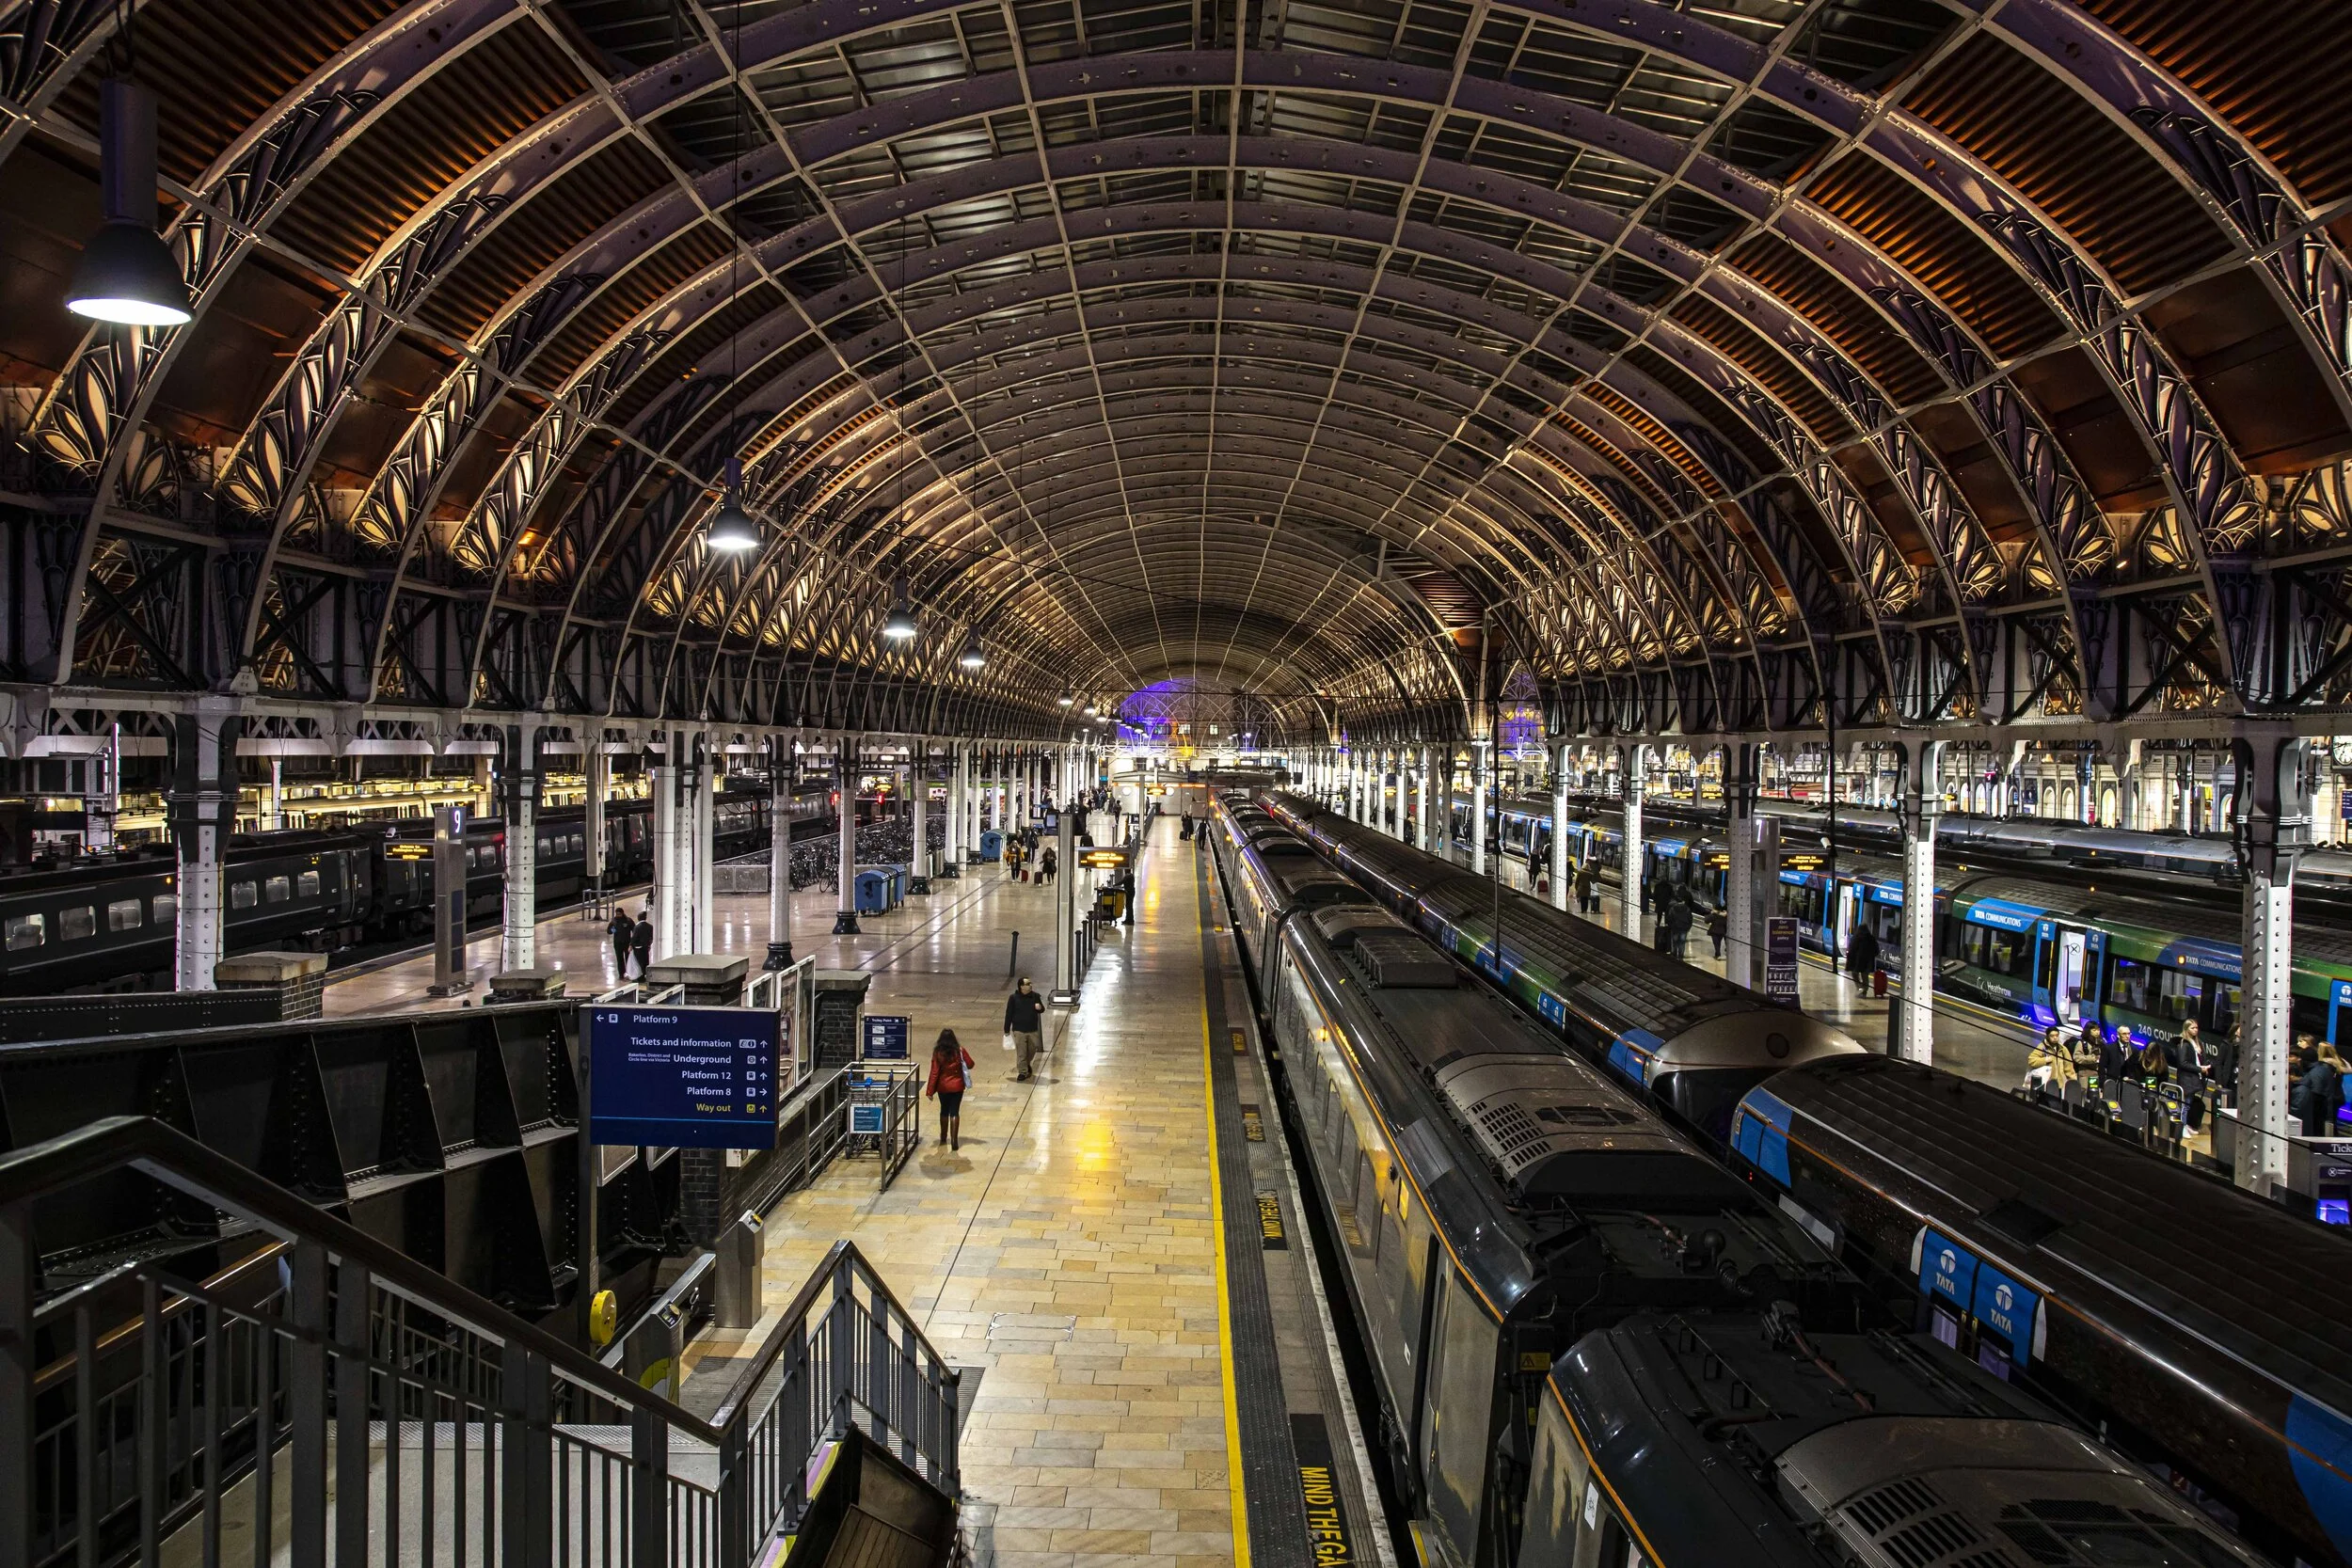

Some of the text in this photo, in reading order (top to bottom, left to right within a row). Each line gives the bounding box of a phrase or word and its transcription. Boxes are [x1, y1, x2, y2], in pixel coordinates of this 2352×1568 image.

[453, 810, 461, 833] 9
[1975, 910, 2022, 927] TATA COMMUNICATIONS
[2185, 956, 2200, 965] TATA
[1987, 981, 2011, 998] Heathrow
[633, 1015, 670, 1023] Platform
[2137, 1023, 2153, 1037] 240
[630, 1037, 731, 1048] Tickets and information
[674, 1054, 732, 1065] Underground
[681, 1070, 732, 1080] Platform 12
[687, 1086, 723, 1095] Platform
[696, 1103, 714, 1113] Way
[2330, 1144, 2352, 1153] Tick
[1261, 1208, 1280, 1221] THE
[1263, 1220, 1283, 1238] MIND
[1936, 1272, 1955, 1295] TATA
[1991, 1308, 2011, 1334] TATA
[1299, 1466, 1348, 1567] MIND THE GA
